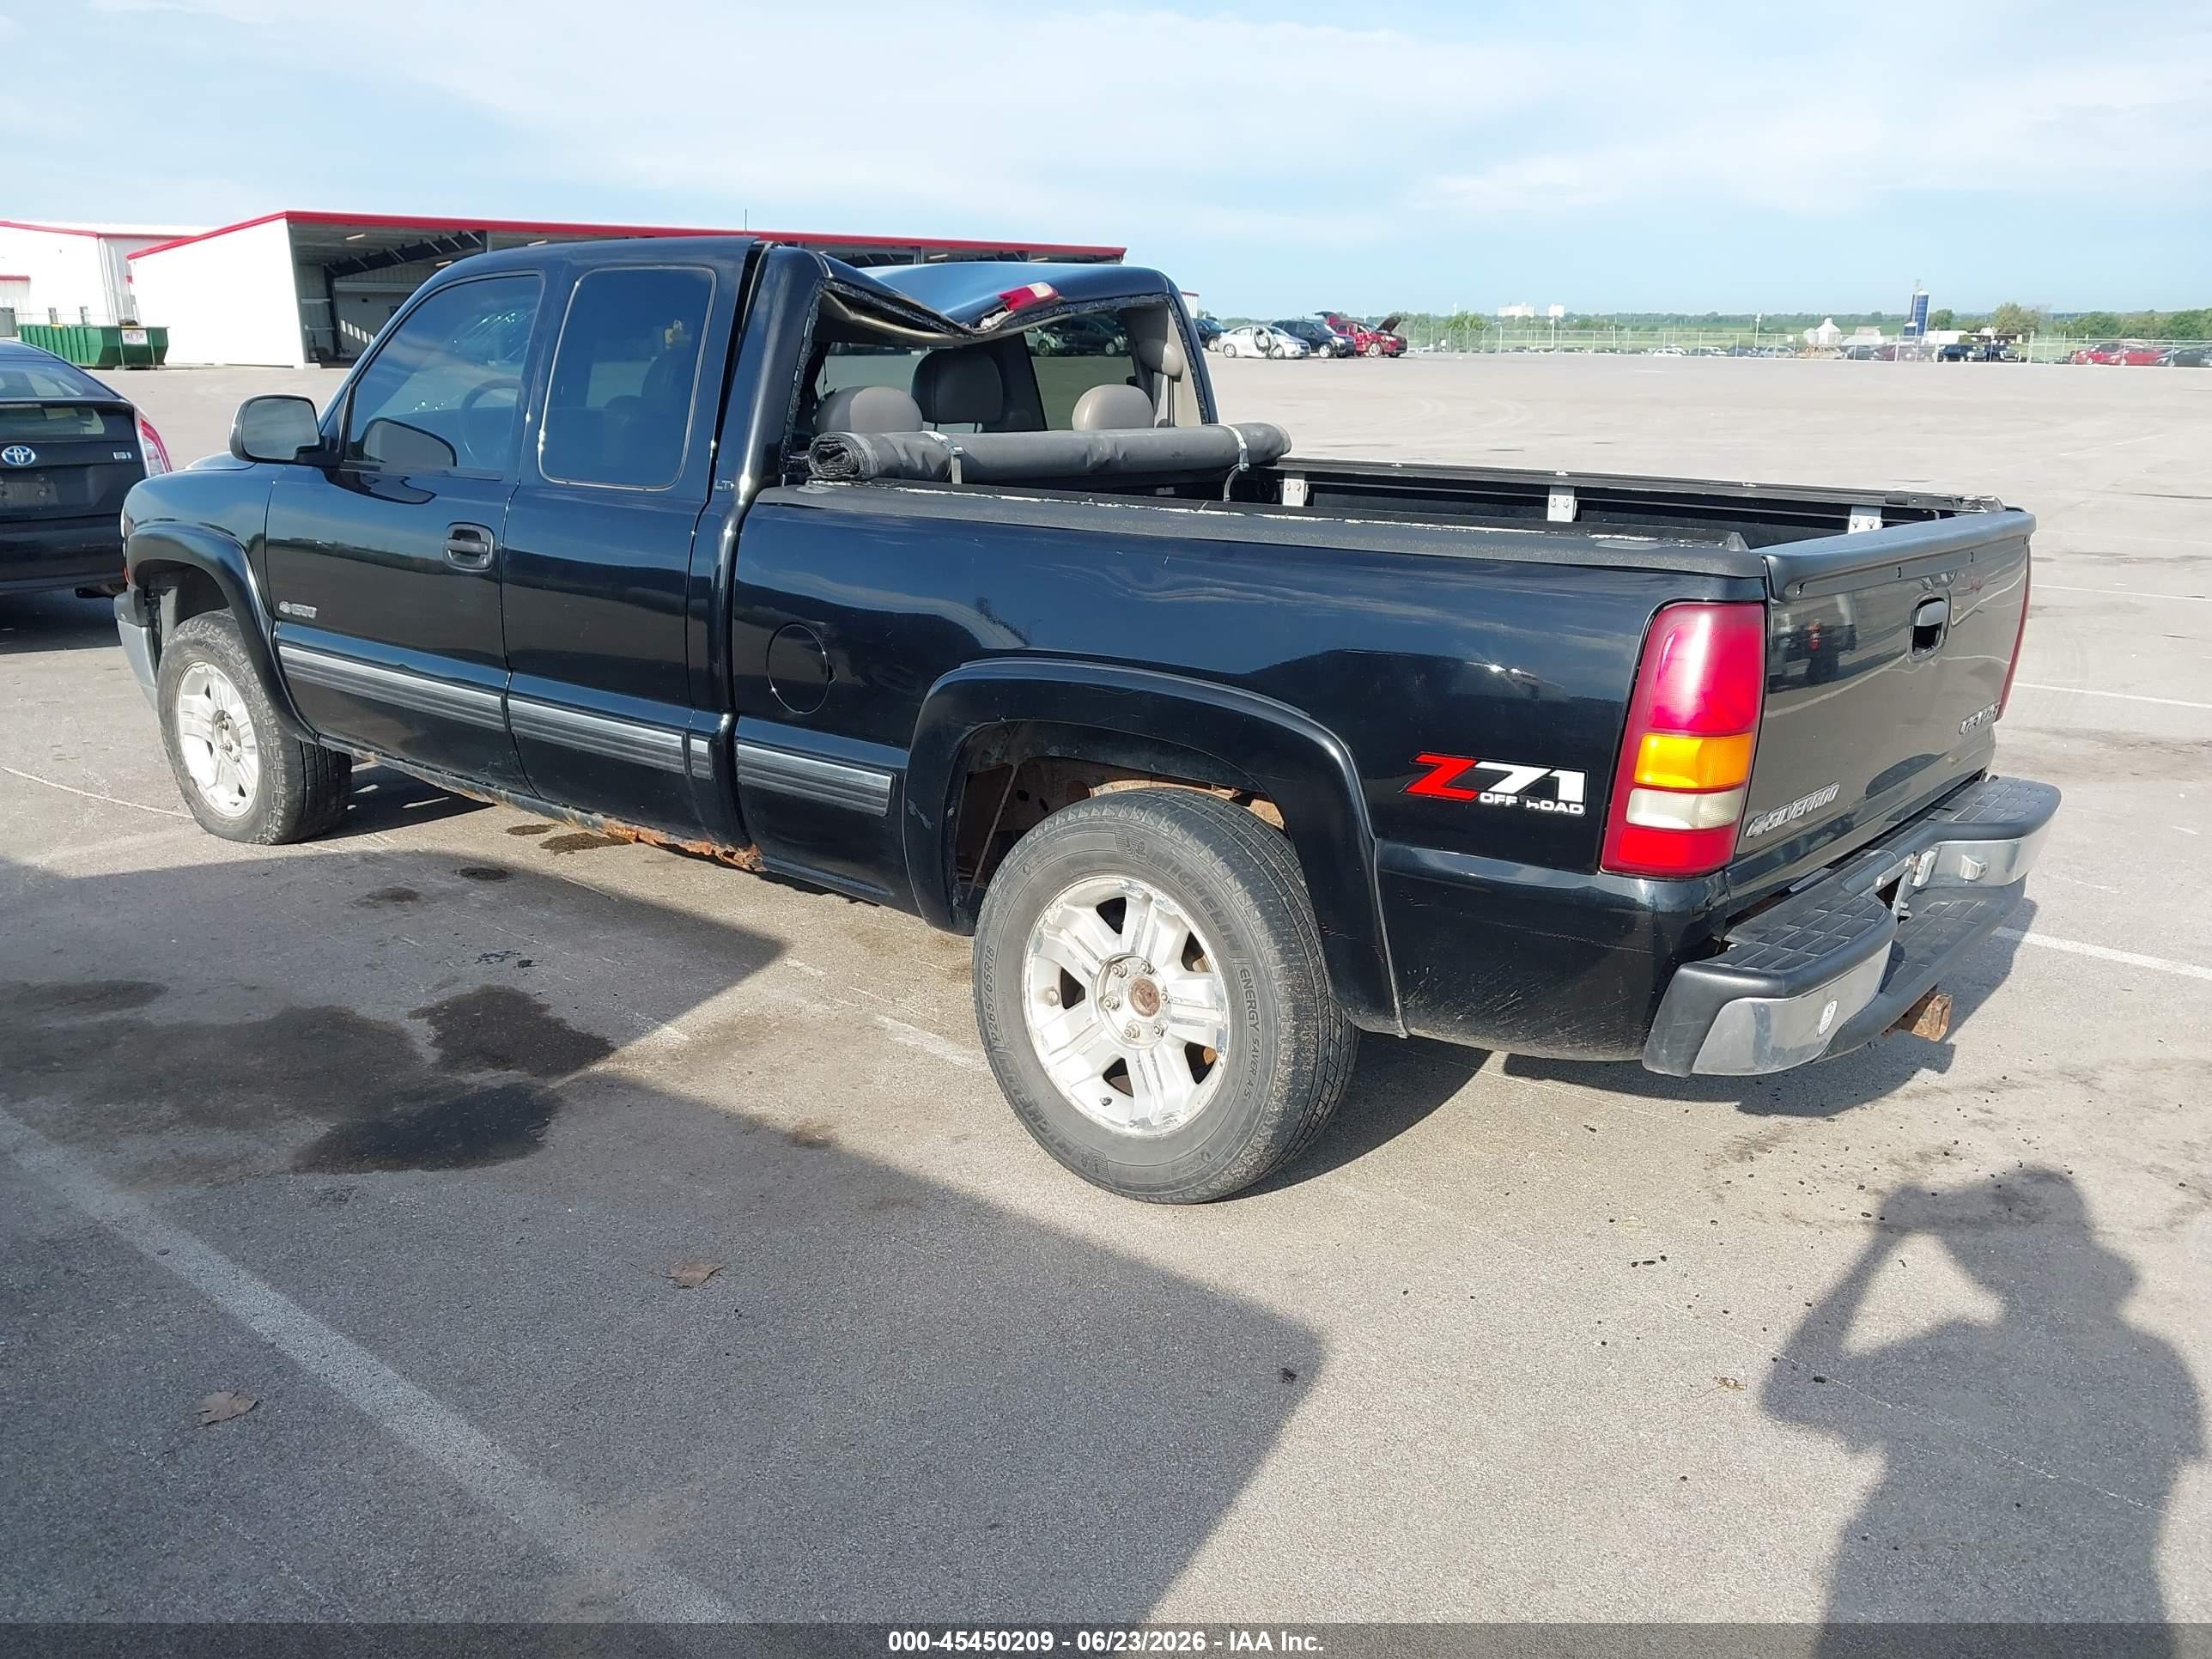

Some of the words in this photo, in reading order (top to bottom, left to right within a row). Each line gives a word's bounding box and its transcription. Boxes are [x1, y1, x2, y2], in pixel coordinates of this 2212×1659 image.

[1406, 753, 1586, 803] Z71
[1479, 792, 1518, 806] OFF
[1765, 782, 1840, 831] SILVERADO
[1148, 850, 1244, 951] MICHELIN
[983, 945, 1002, 1042] P265/65R18
[1239, 967, 1260, 1032] ENERGY
[1249, 1037, 1261, 1077] SAVER
[1244, 1079, 1255, 1101] A/S
